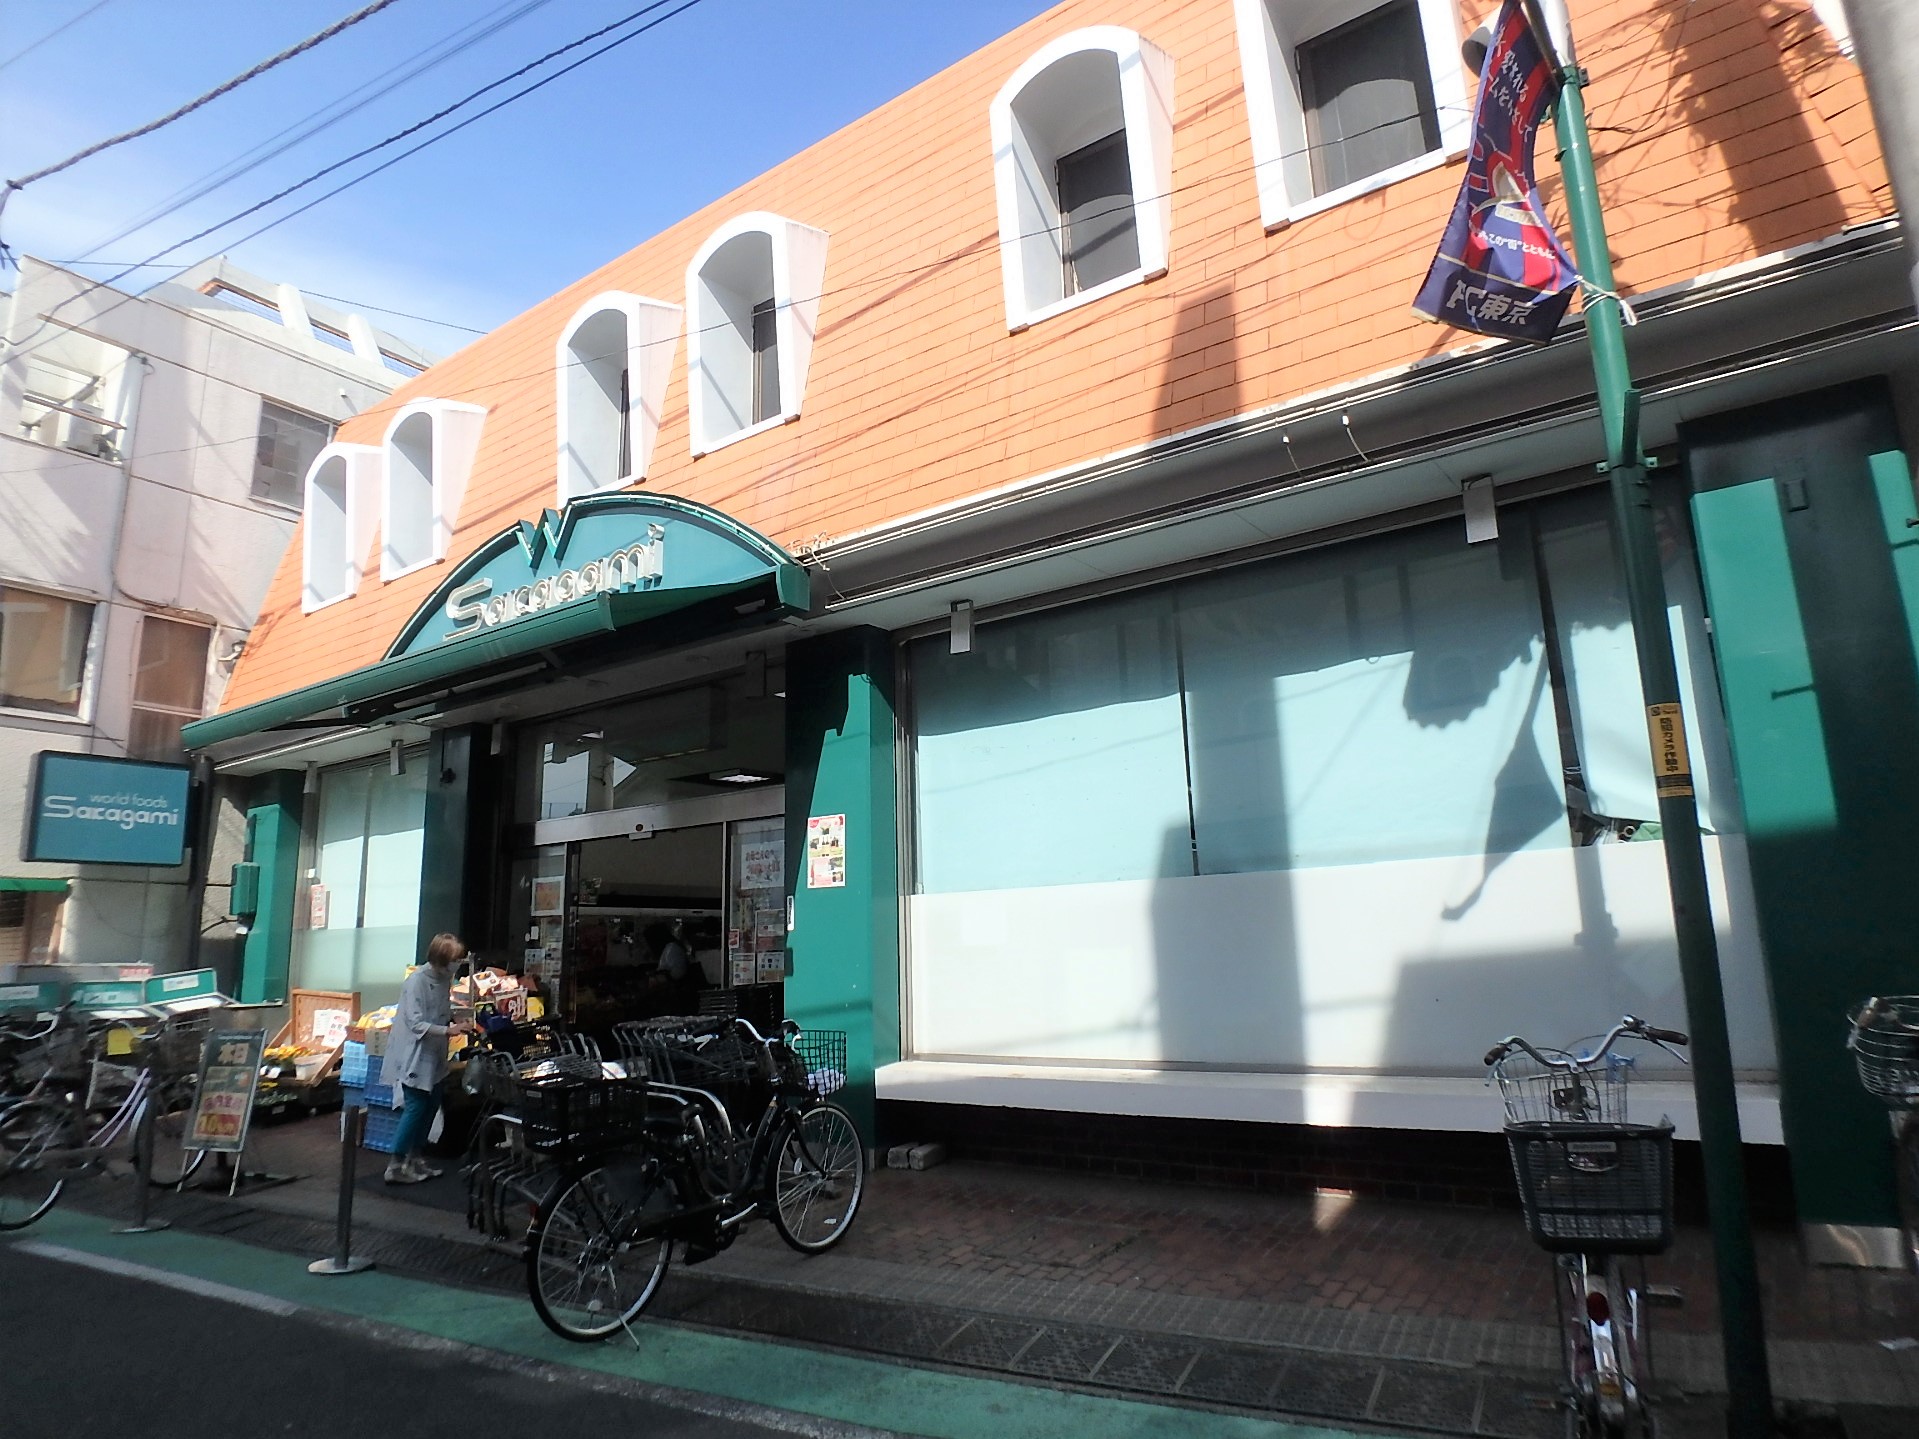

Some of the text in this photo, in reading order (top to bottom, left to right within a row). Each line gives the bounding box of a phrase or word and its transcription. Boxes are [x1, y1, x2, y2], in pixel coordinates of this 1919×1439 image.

[1446, 279, 1539, 325] FC東京
[89, 792, 168, 808] world foods
